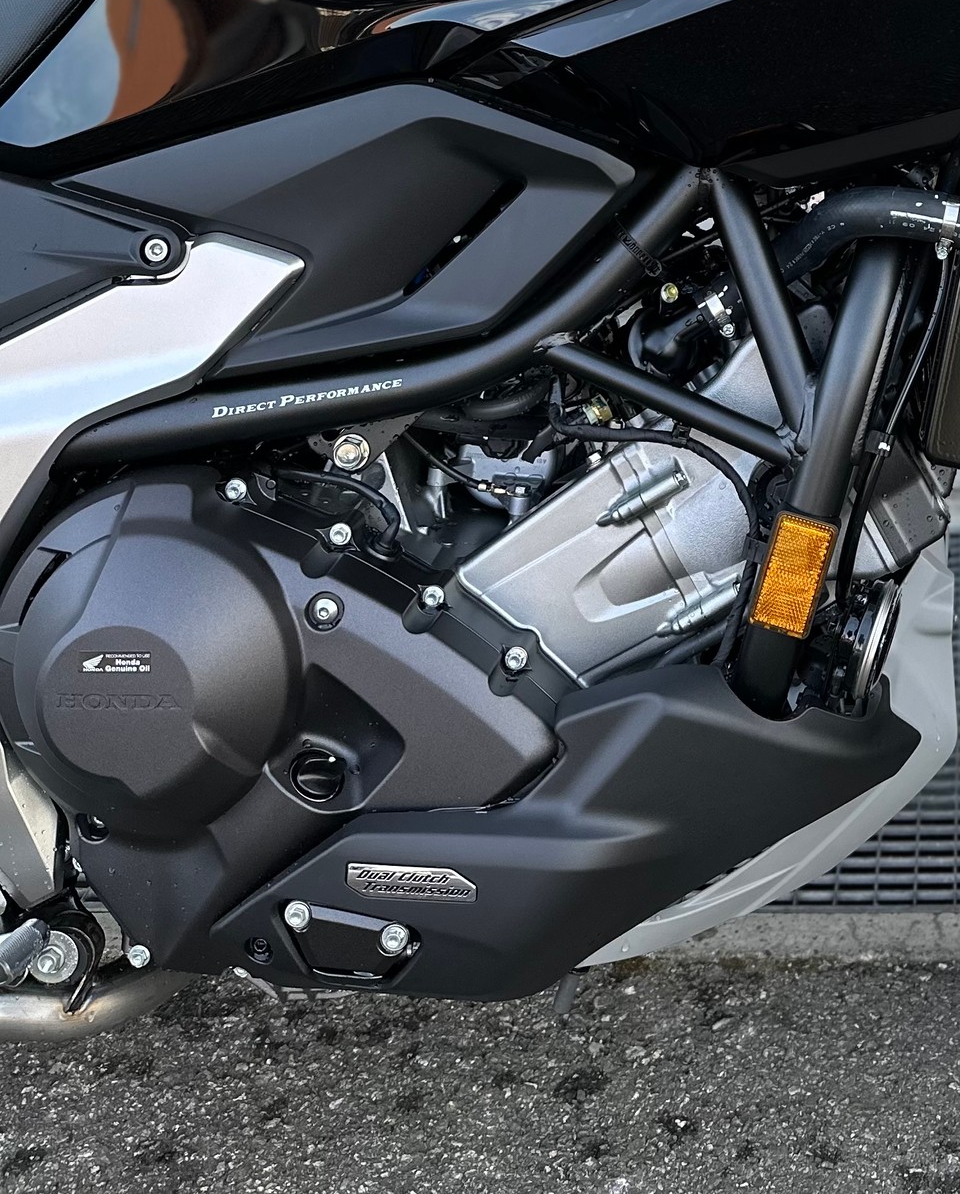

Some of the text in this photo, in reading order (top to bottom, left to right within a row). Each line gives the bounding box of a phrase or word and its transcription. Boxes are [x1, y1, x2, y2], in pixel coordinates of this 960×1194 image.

[55, 693, 182, 711] HONDA
[356, 869, 450, 885] Dual Clutch
[362, 881, 471, 898] Transmission
